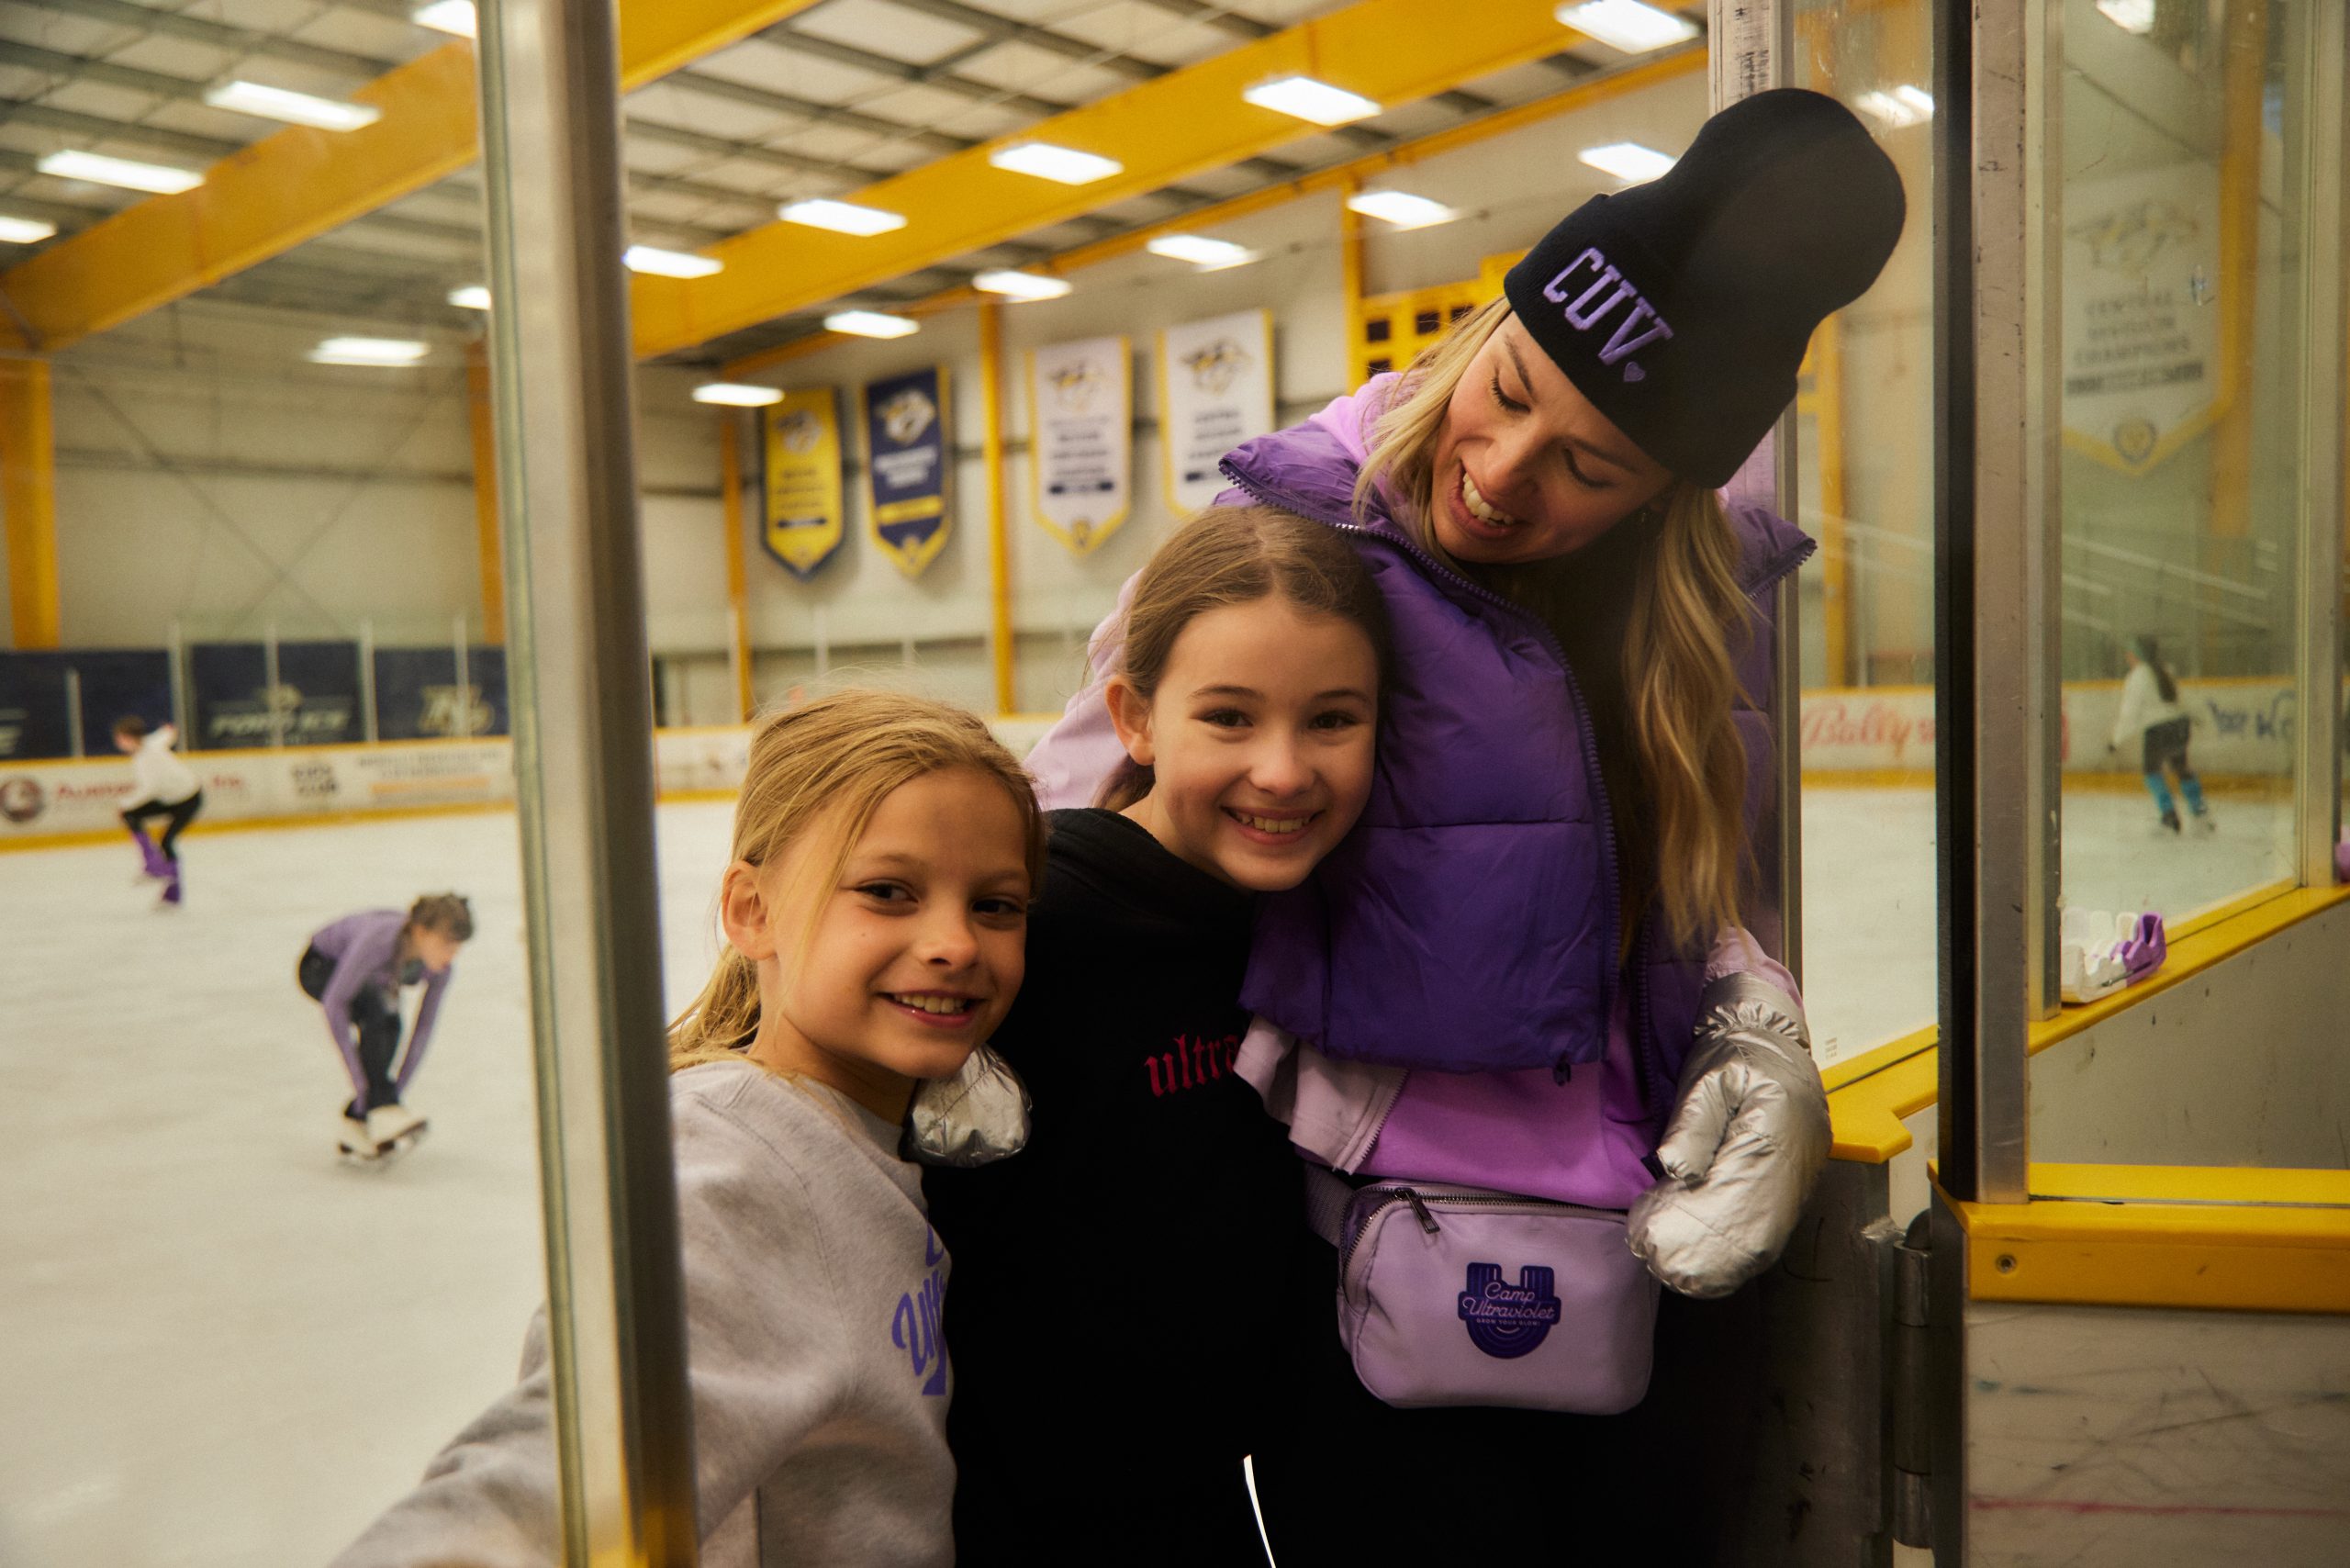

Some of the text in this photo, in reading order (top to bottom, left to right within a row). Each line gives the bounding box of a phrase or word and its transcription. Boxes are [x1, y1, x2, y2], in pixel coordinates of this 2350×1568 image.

[1543, 247, 1674, 365] CUV
[1484, 1282, 1535, 1304] Camp
[1462, 1297, 1556, 1319] Ultraviolet
